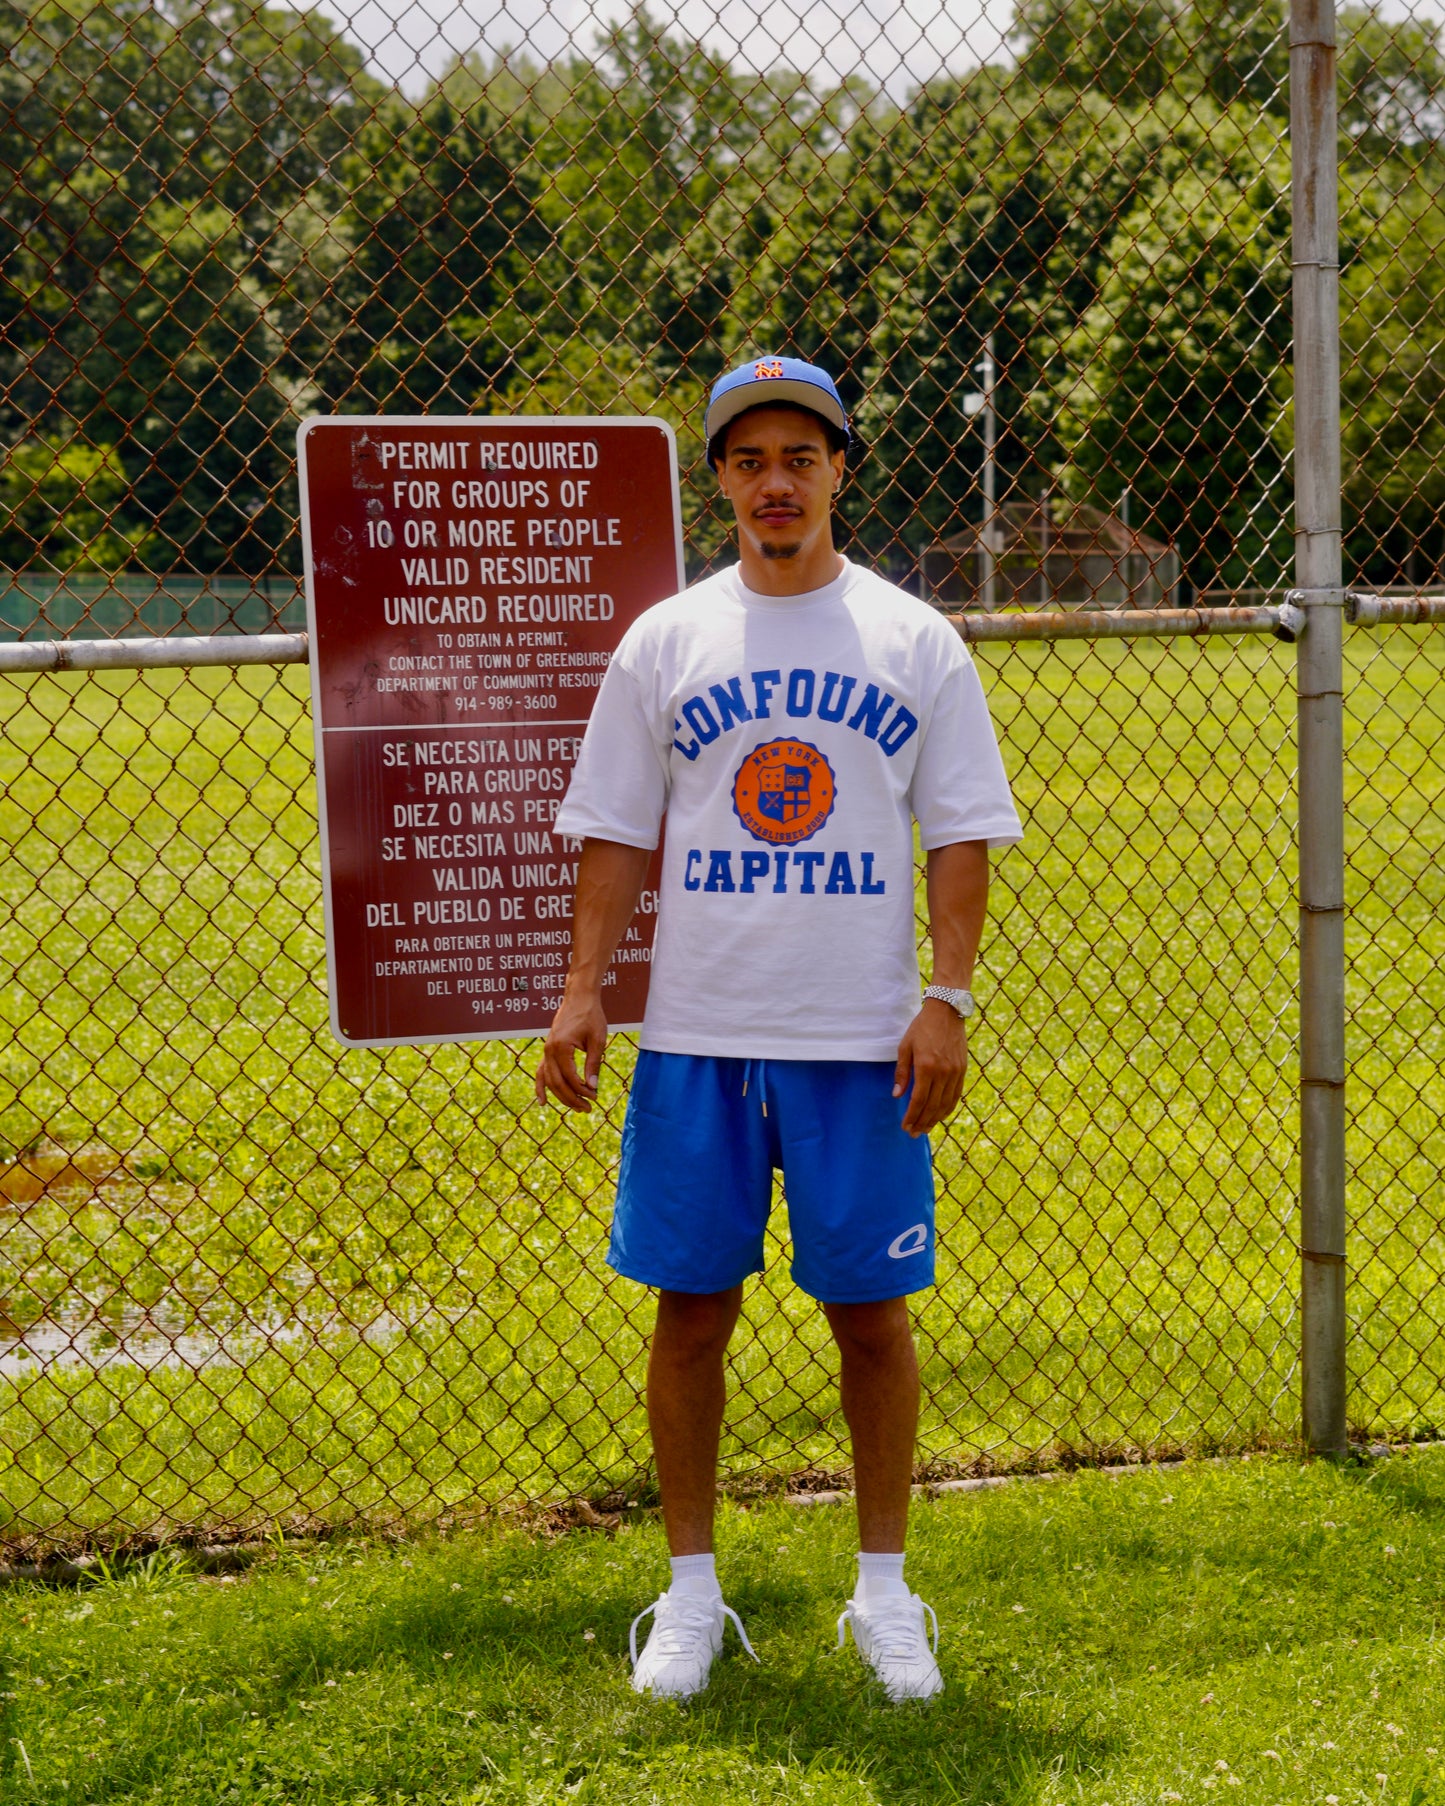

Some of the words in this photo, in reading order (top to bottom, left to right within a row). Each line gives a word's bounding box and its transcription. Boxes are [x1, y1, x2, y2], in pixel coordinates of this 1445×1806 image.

[382, 442, 469, 469] PERMIT
[481, 442, 598, 469] REQUIRED
[394, 481, 440, 508] FOR
[452, 481, 549, 508] GROUPS
[560, 481, 590, 507] OF
[368, 520, 394, 548] 10
[404, 520, 437, 547] OR
[449, 519, 516, 547] MORE
[528, 519, 622, 547] PEOPLE
[401, 558, 469, 586] VALID
[481, 556, 593, 584] RESIDENT
[384, 596, 486, 625] UNICARD
[498, 594, 614, 623] REQUIRED
[437, 634, 453, 648] TO
[458, 633, 500, 648] OBTAIN
[506, 634, 514, 646] A
[389, 656, 444, 671] CONTACT
[450, 655, 472, 669] THE
[477, 654, 512, 668] TOWN
[517, 654, 532, 668] OF
[377, 677, 458, 692] DEPARTMENT
[463, 676, 479, 690] OF
[483, 674, 554, 690] COMMUNITY
[559, 672, 605, 687] RESOUR
[673, 668, 918, 762] CONFOUND
[383, 744, 408, 766] SE
[415, 740, 510, 765] NECESITA
[515, 739, 544, 763] UN
[548, 738, 582, 761] PER
[753, 747, 780, 766] NEW
[787, 746, 820, 767] YORK
[424, 770, 479, 795] PARA
[485, 768, 564, 792] GRUPOS
[393, 804, 439, 828] DIEZ
[449, 804, 462, 826] O
[472, 801, 515, 825] MAS
[524, 799, 560, 823] PER
[743, 811, 805, 841] ESTABLISHED
[807, 810, 825, 833] 2000
[382, 837, 406, 861] SE
[415, 834, 506, 860] NECESITA
[514, 832, 553, 855] UNA
[433, 866, 504, 892] VALIDA
[511, 863, 579, 888] UNICA
[684, 849, 886, 895] CAPITAL
[366, 902, 405, 928] DEL
[414, 898, 490, 925] PUEBLO
[501, 896, 525, 921] DE
[395, 938, 429, 954] PARA
[434, 934, 490, 952] OBTENER
[495, 933, 512, 948] UN
[626, 928, 642, 942] AL
[376, 956, 472, 976] DEPARTAMENTO
[478, 955, 494, 970] DE
[500, 952, 563, 970] SERVICIOS
[427, 980, 452, 995] DEL
[457, 977, 506, 993] PUEBLO
[512, 977, 528, 991] DE
